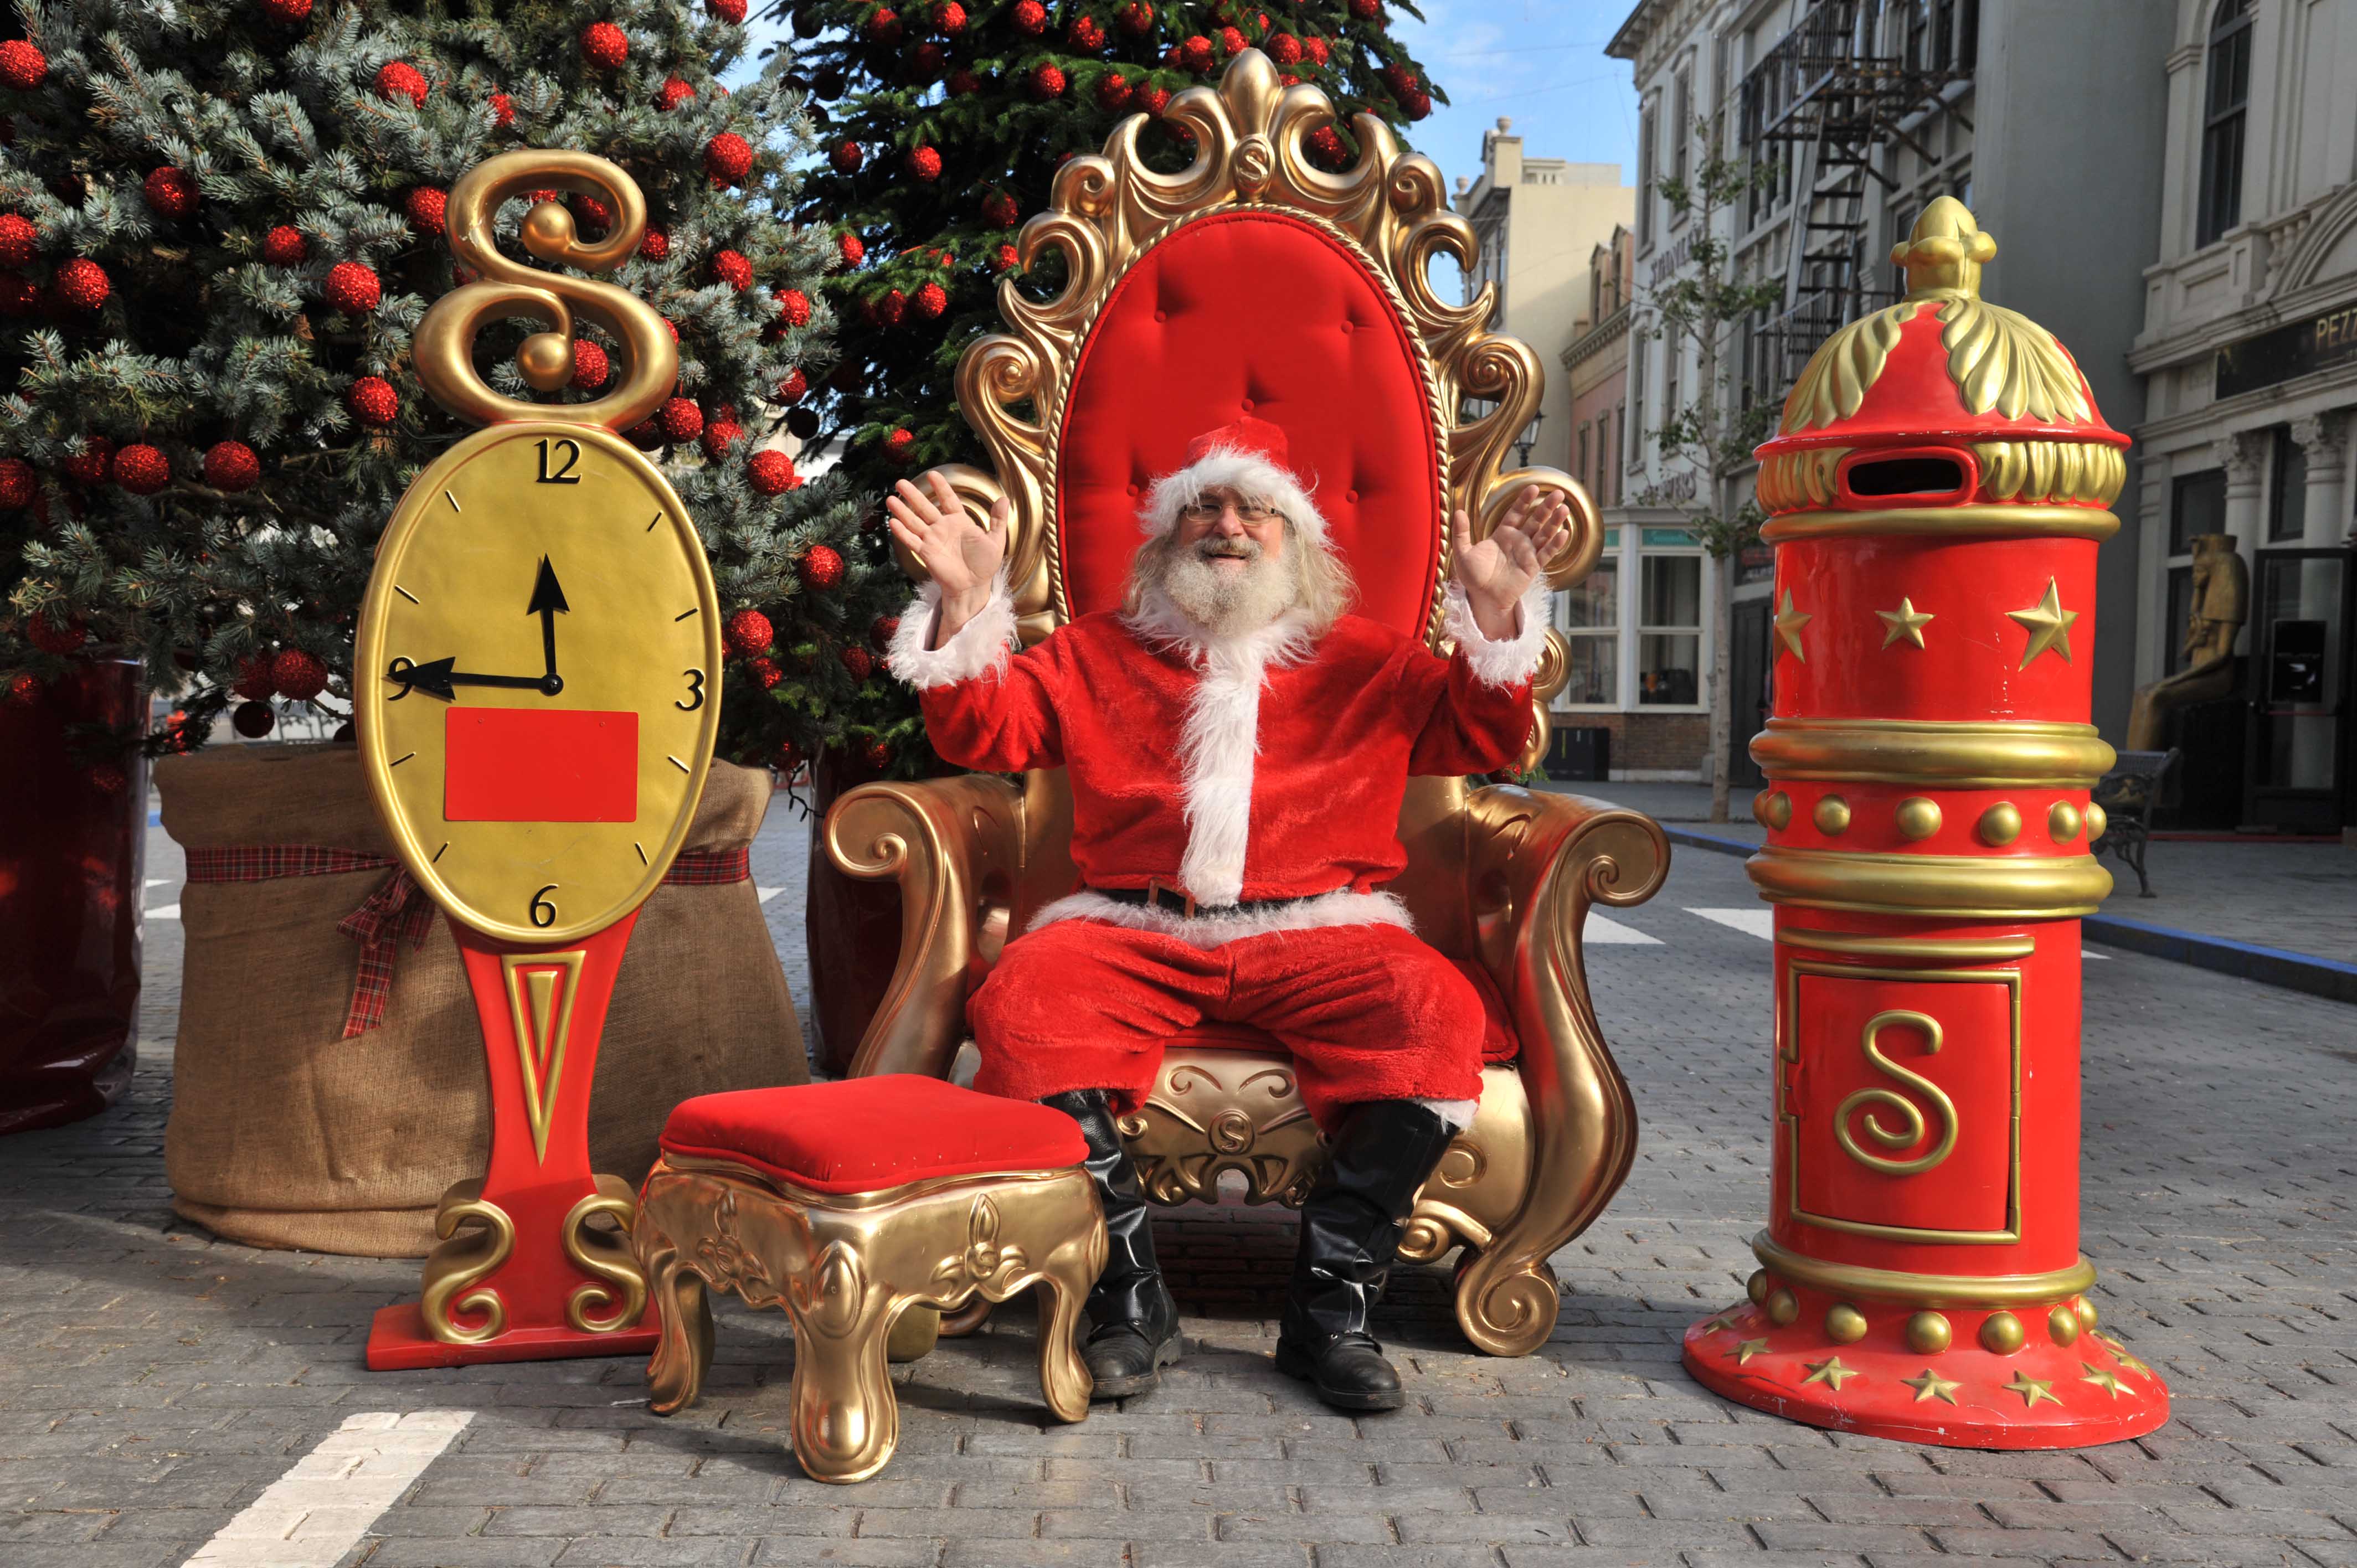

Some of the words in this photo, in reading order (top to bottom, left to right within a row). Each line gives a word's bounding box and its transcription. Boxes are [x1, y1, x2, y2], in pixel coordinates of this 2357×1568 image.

[534, 439, 581, 483] 12
[387, 657, 417, 701] 9
[676, 669, 704, 711] 3
[530, 885, 558, 927] 6
[1834, 1010, 1958, 1174] S
